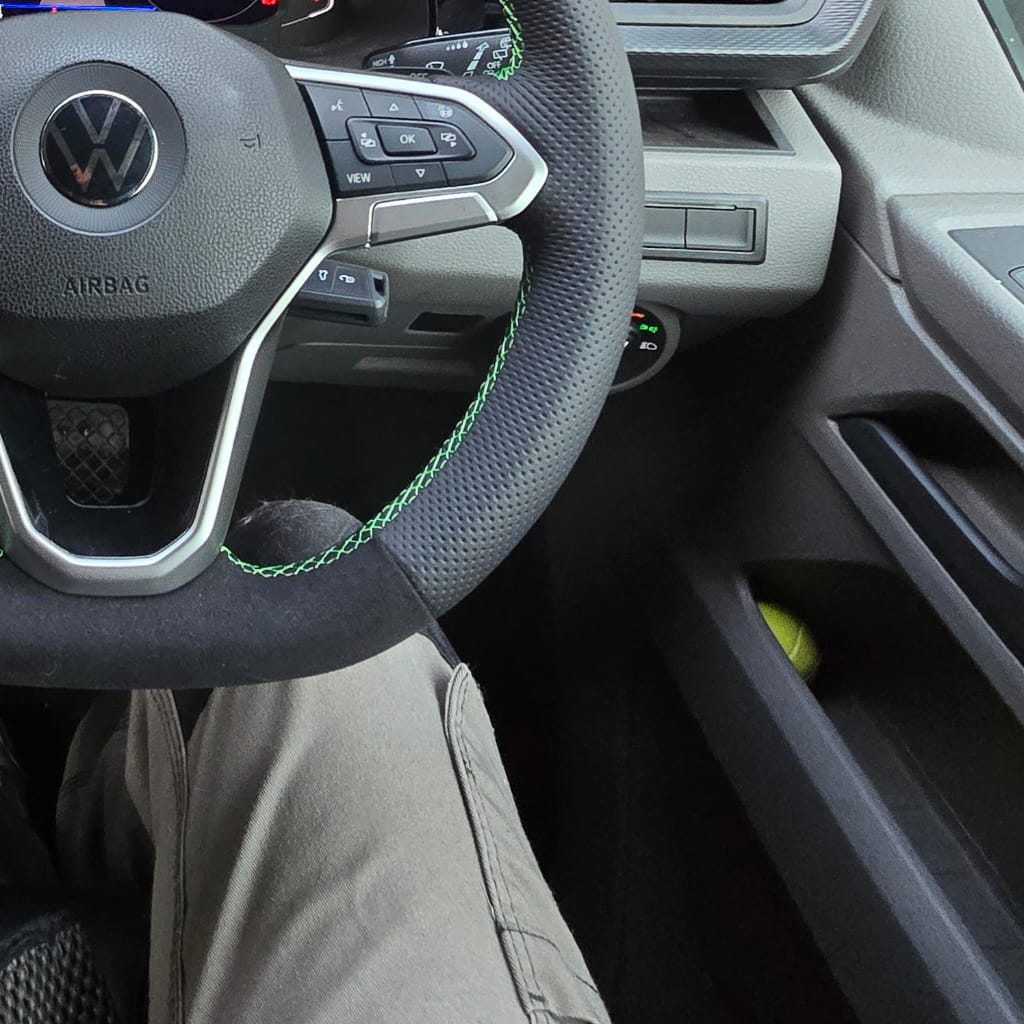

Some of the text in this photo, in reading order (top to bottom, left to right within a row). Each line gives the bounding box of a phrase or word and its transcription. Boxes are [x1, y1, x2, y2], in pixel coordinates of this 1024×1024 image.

[399, 133, 417, 145] OK
[346, 173, 372, 185] VIEW
[62, 276, 150, 297] AIRBAG
